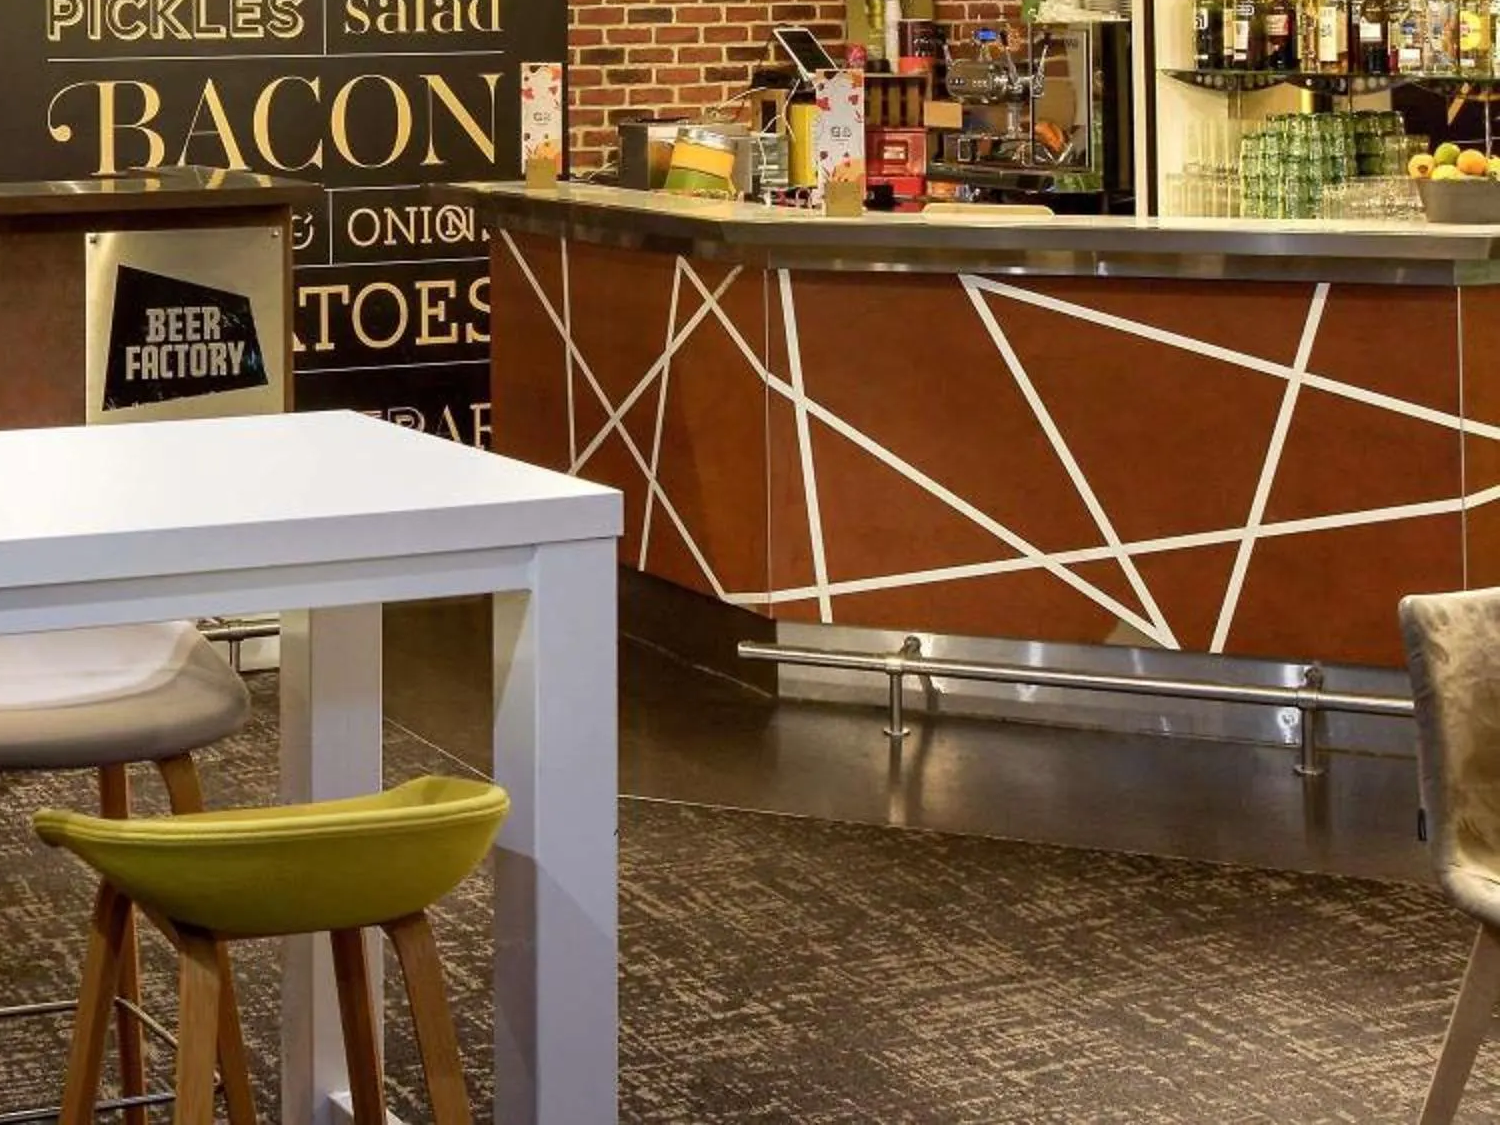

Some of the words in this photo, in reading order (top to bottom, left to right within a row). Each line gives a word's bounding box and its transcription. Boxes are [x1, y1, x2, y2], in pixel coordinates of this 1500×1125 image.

[47, 74, 504, 176] BACON
[145, 306, 221, 343] BEER
[125, 341, 245, 380] FACTORY
